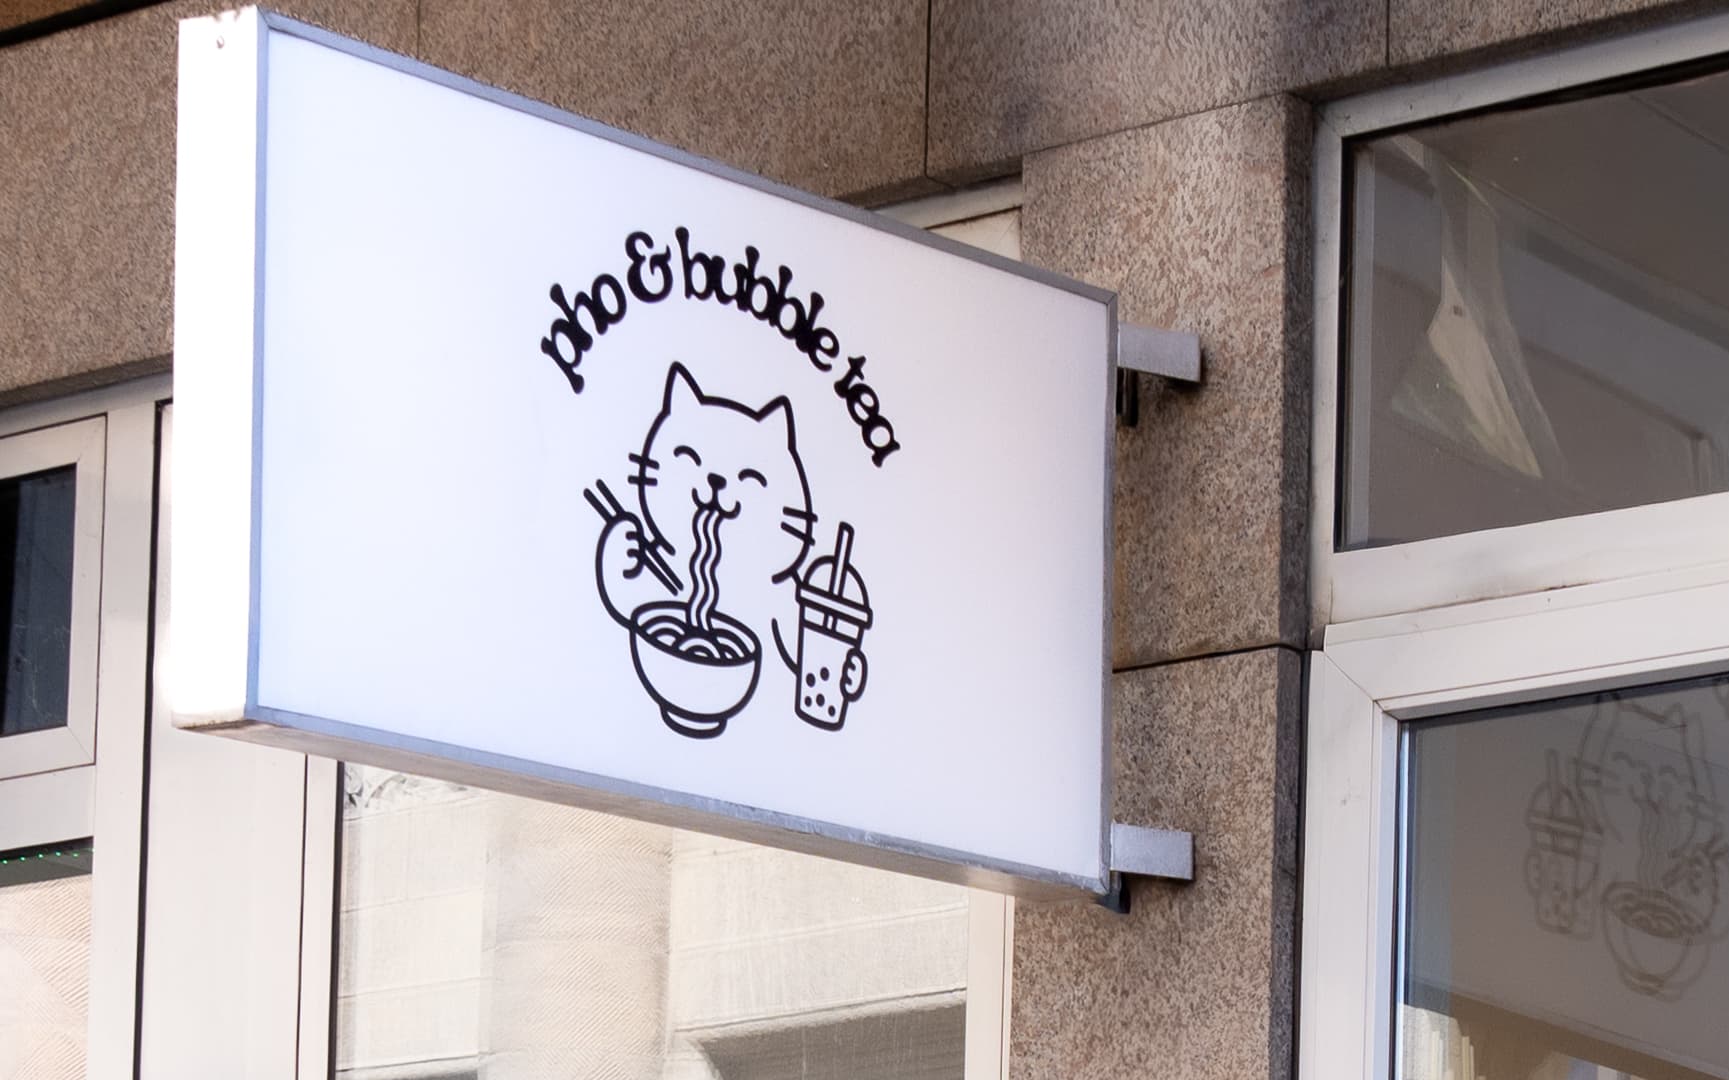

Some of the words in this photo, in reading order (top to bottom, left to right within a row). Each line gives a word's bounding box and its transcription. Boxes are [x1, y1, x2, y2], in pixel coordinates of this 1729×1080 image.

[540, 272, 627, 394] pho
[625, 230, 674, 303] &
[675, 226, 841, 371] bubble
[833, 355, 902, 468] tea
